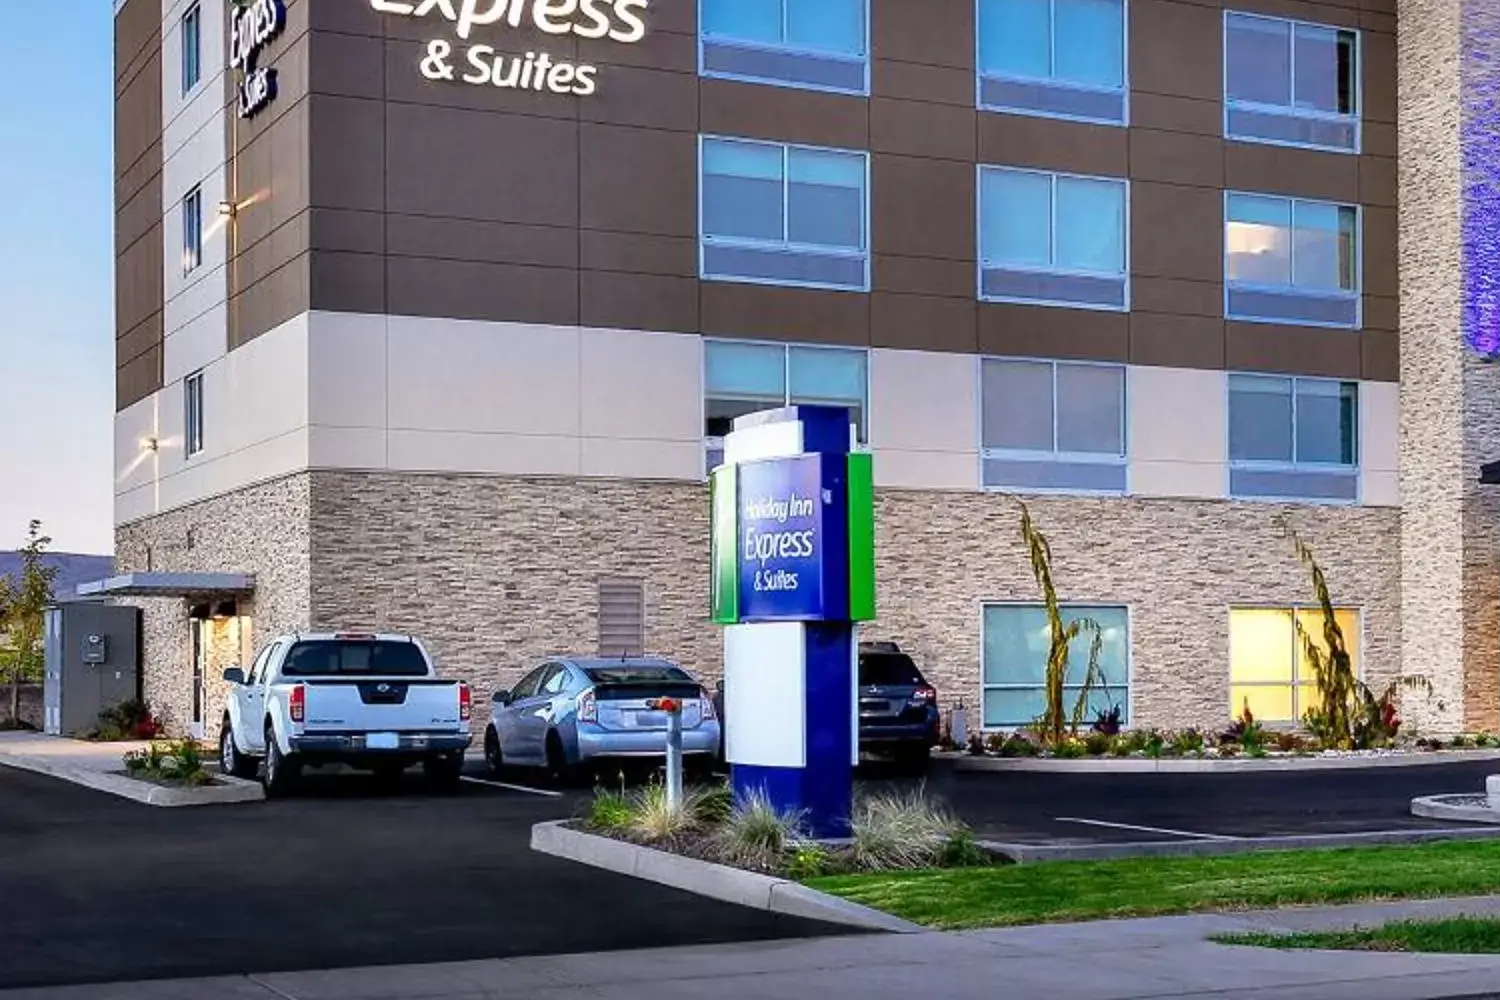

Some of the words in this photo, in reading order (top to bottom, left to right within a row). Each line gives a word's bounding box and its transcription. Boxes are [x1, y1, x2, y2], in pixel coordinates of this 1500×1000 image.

[419, 39, 454, 81] &
[463, 44, 597, 96] Suites
[789, 492, 813, 517] Inn
[745, 527, 814, 568] Express
[753, 570, 763, 592] &
[763, 569, 798, 591] Suites
